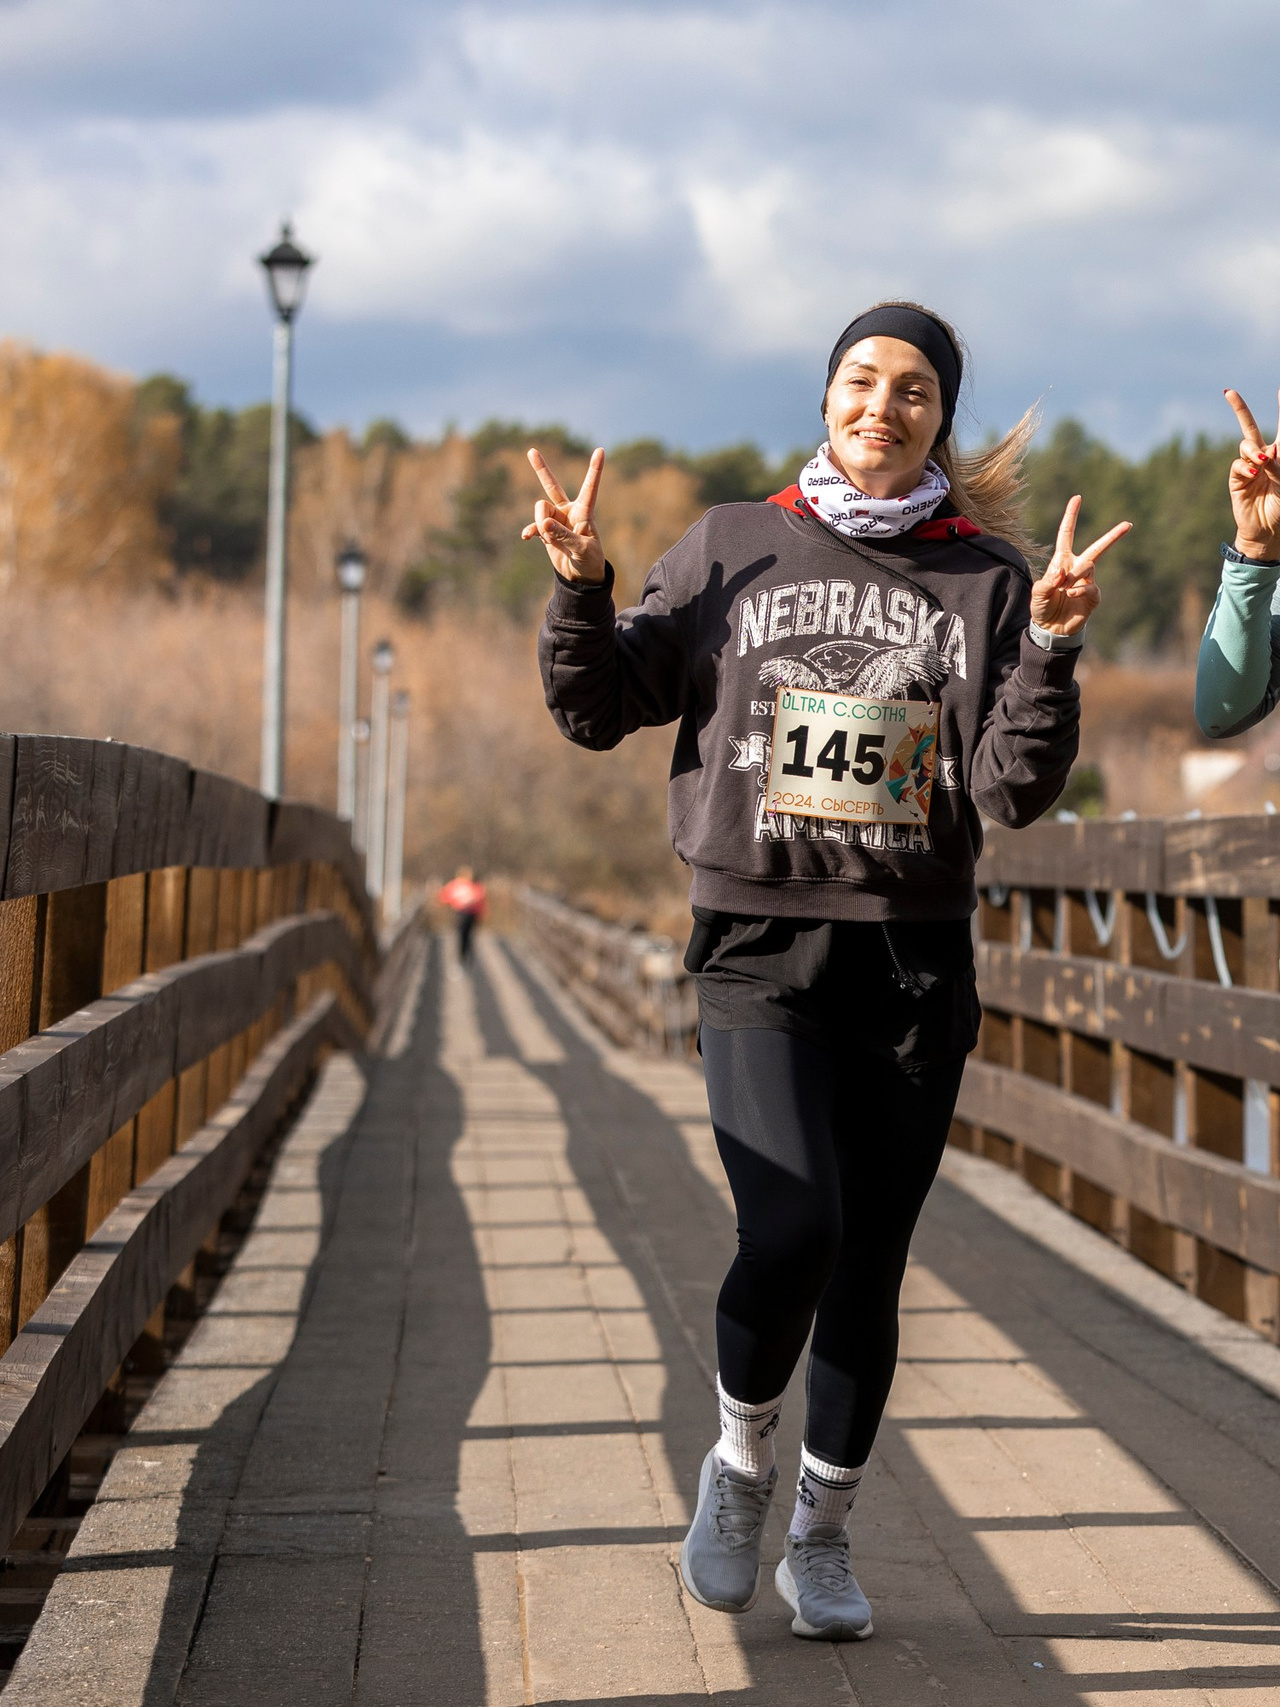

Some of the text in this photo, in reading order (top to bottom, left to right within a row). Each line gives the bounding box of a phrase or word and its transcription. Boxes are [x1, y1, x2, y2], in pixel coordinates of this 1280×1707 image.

[737, 579, 967, 681] NEBRASKA
[782, 693, 907, 722] ULTRA С.СОТНЯ
[781, 725, 887, 786] 145
[772, 791, 885, 816] 2024. СЫСЕРТЬ
